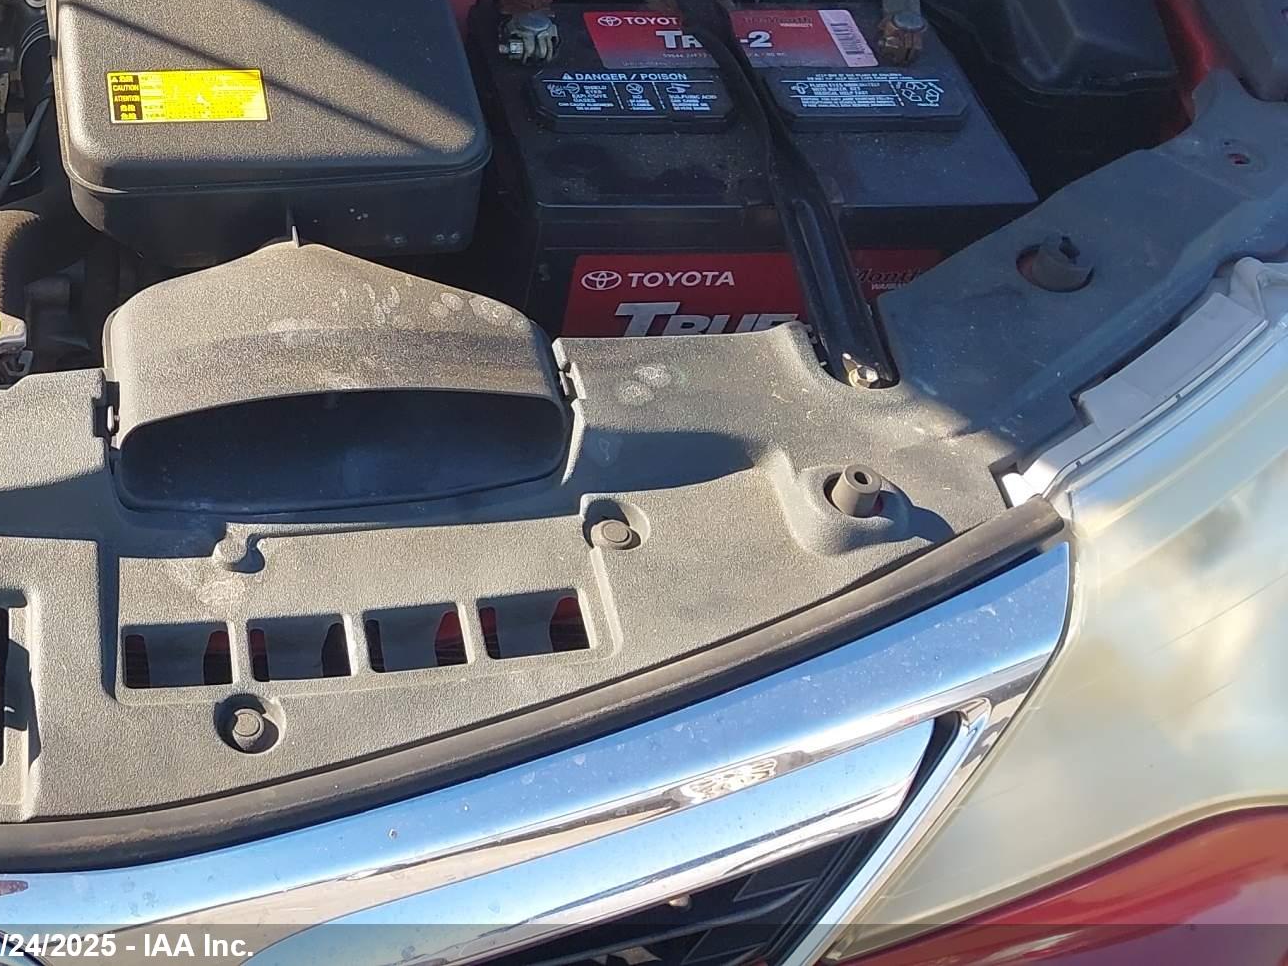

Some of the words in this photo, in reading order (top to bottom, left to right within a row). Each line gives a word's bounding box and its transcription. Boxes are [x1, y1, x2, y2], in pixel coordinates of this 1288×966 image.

[623, 15, 679, 26] TOYOT
[574, 73, 628, 81] DANGER
[639, 73, 687, 81] POISON
[112, 84, 140, 92] CAUTION
[627, 271, 735, 288] TOYOTA
